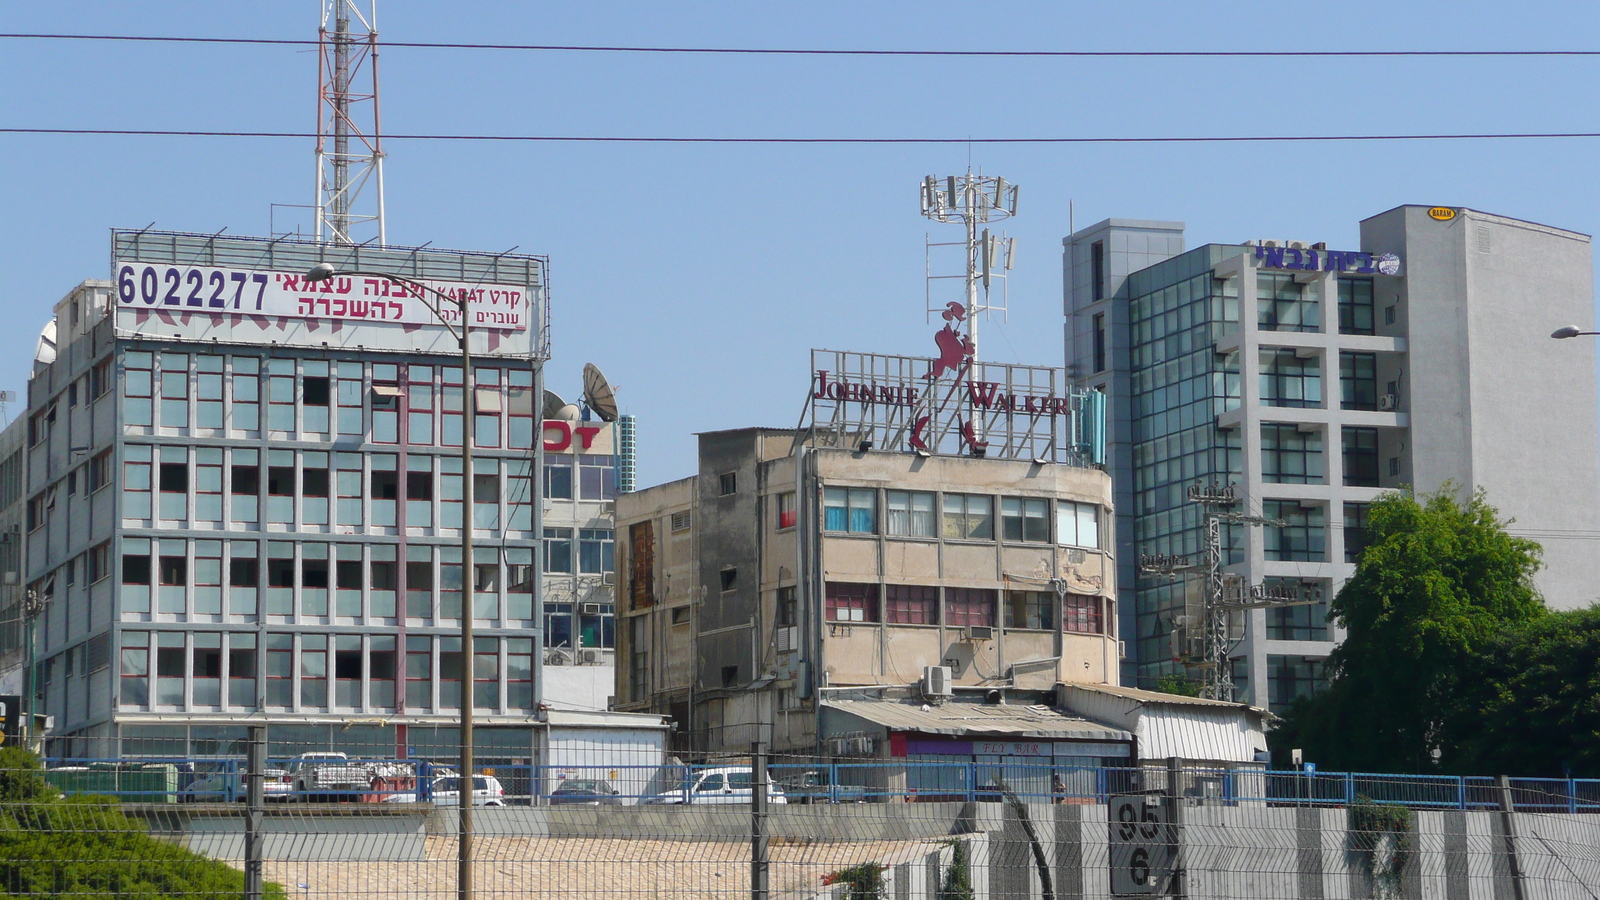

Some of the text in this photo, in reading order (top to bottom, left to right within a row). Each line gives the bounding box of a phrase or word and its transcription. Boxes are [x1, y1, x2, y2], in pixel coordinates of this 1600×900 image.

[1432, 209, 1452, 218] BARAM
[1325, 250, 1375, 274] בית
[118, 265, 268, 310] 6022277
[275, 273, 426, 299] מבנה עצמאי
[298, 297, 403, 320] להשכרה
[489, 289, 521, 310] קרט
[441, 309, 519, 324] עוברים ירה
[966, 381, 1071, 415] WALKER
[1118, 802, 1159, 841] 95
[1130, 847, 1150, 886] 6
